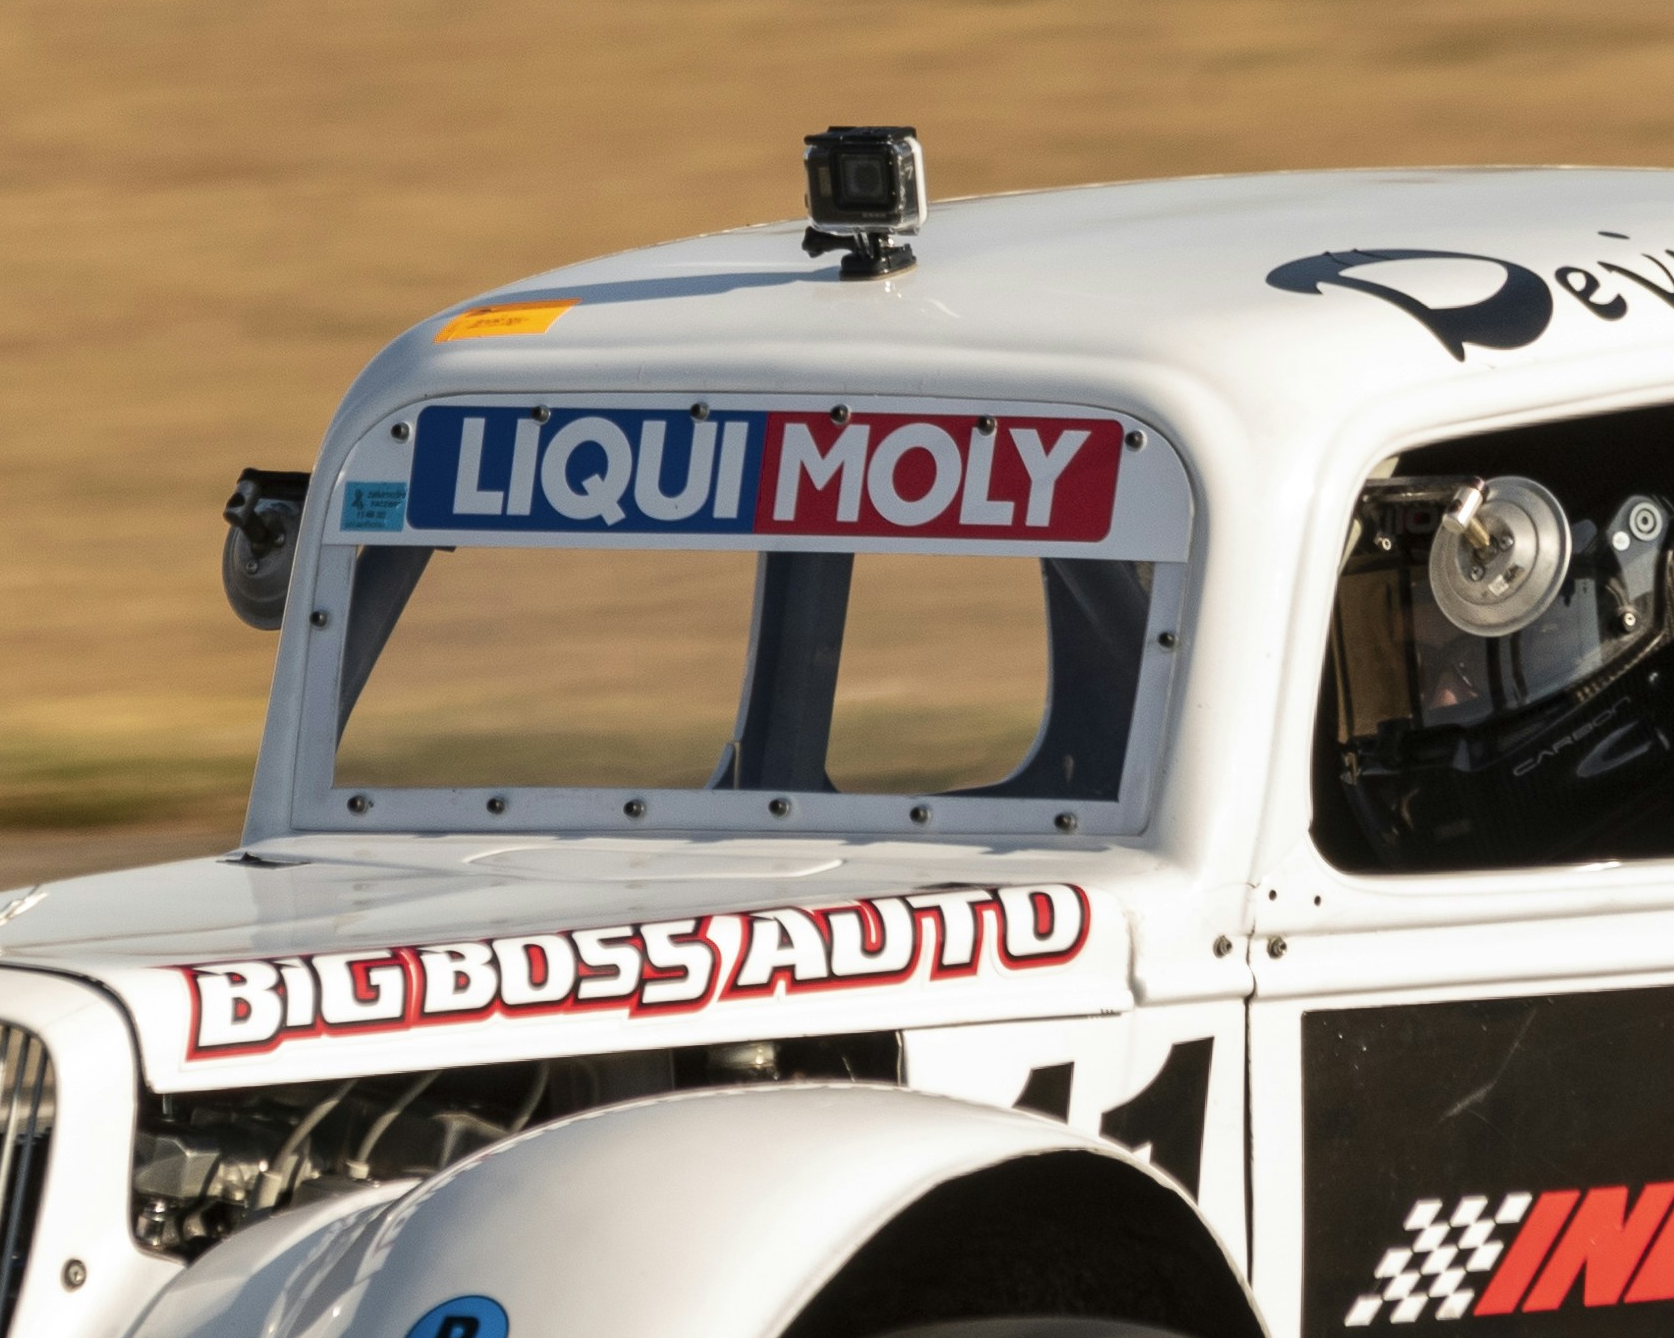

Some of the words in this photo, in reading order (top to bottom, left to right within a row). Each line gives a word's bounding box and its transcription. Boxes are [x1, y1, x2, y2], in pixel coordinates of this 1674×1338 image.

[451, 417, 749, 526] LIQUI
[772, 422, 1091, 528] MOLY
[419, 916, 719, 1017] BOSS
[733, 883, 1087, 990] AUTO
